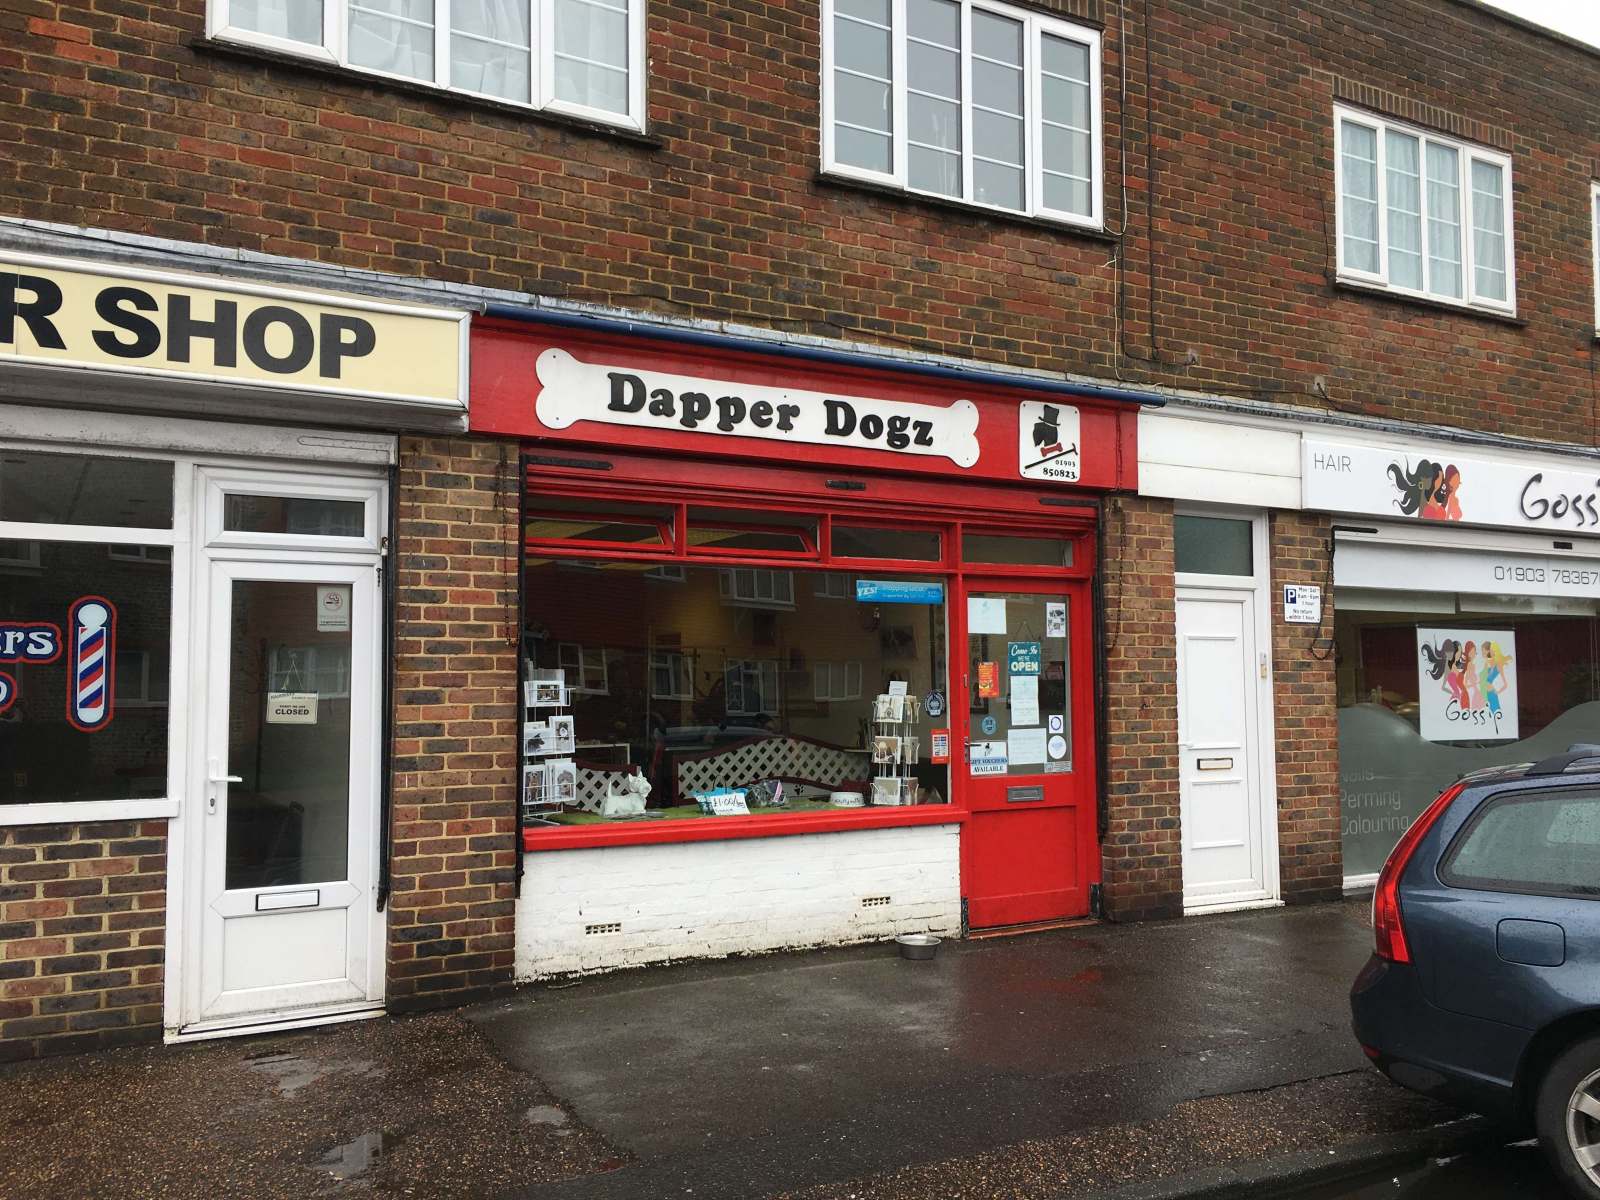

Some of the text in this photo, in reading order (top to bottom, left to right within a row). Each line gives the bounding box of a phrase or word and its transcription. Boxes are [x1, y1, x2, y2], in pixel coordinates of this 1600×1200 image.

[91, 287, 377, 379] SHOP
[607, 372, 934, 449] Dapper Dogz
[1055, 460, 1076, 468] 01903
[1314, 451, 1352, 473] HAIR
[1520, 472, 1600, 527] Goss
[1494, 566, 1600, 585] 01903 78367
[0, 631, 54, 655] rs
[1010, 661, 1039, 672] OPEN
[1446, 699, 1503, 735] Gossip
[973, 765, 1003, 773] AVAILABLE
